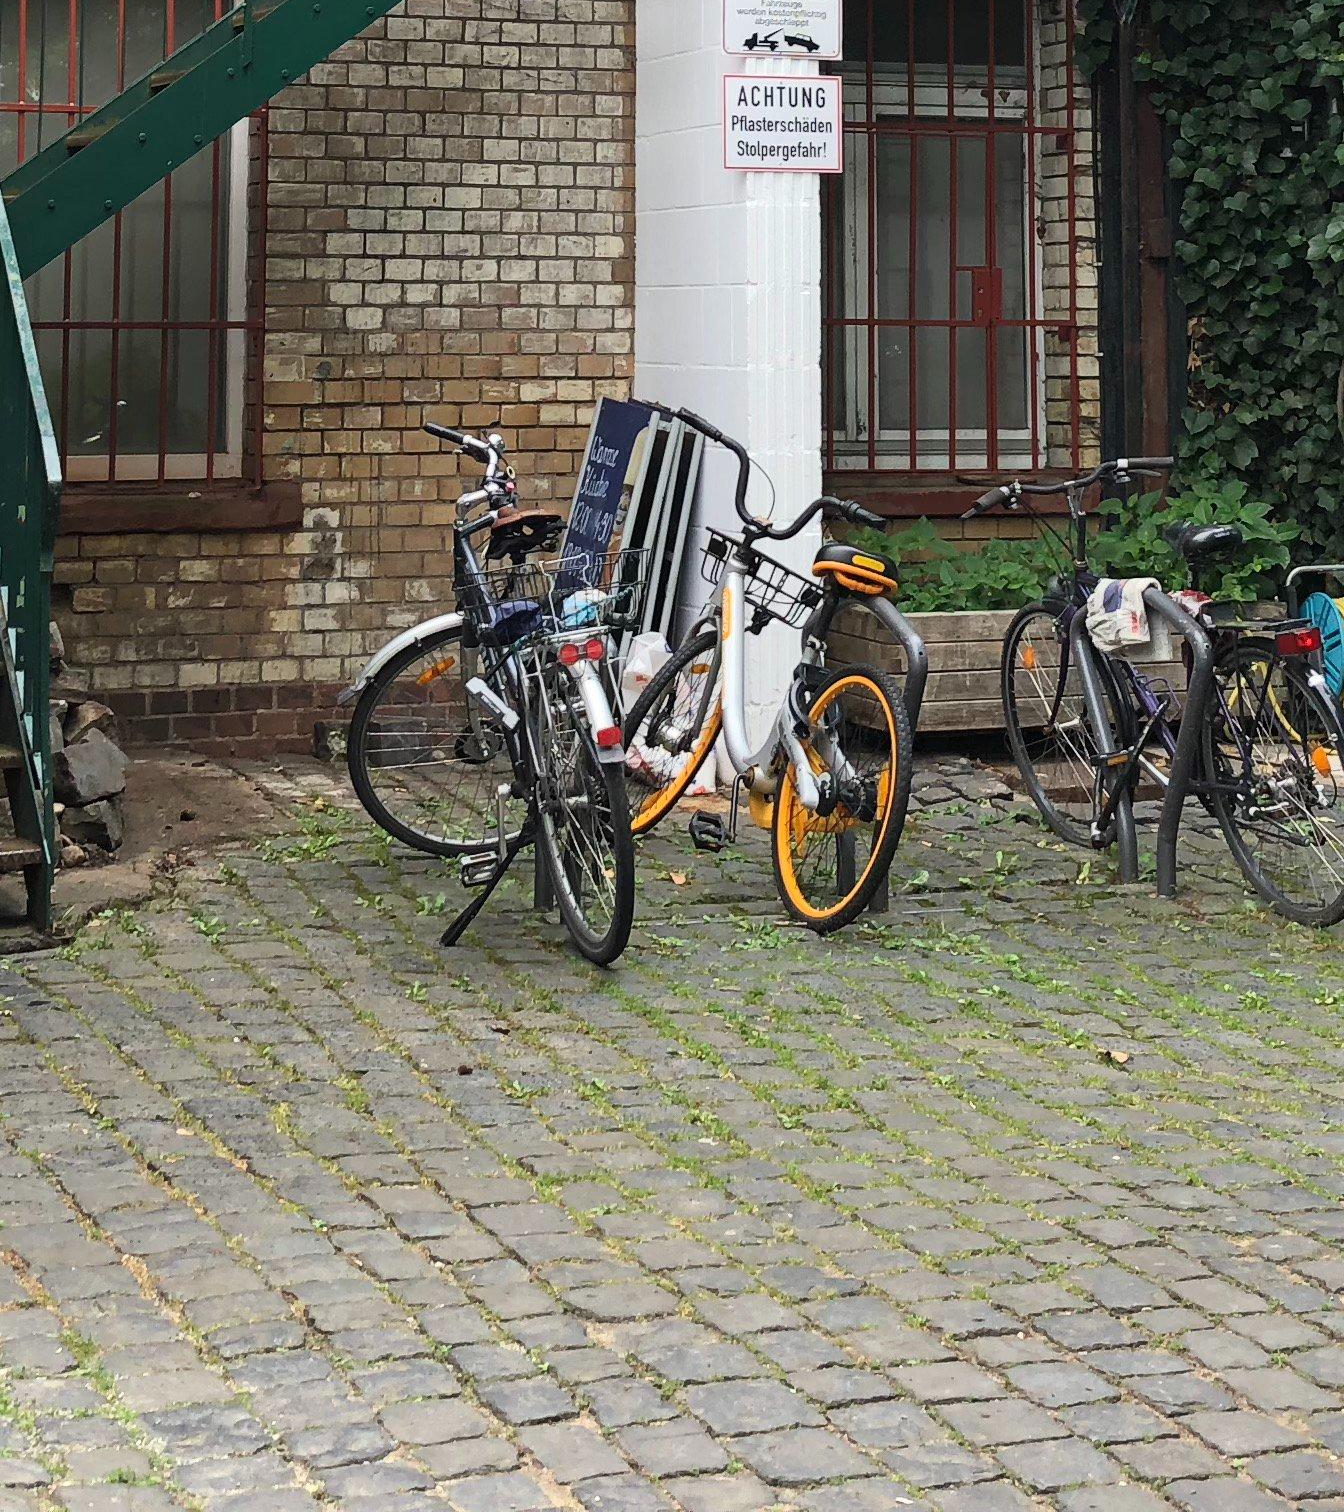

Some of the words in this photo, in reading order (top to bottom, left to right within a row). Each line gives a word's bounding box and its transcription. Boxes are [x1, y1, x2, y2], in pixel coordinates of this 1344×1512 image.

[737, 86, 826, 108] ACHTUNG
[731, 115, 833, 134] Pflasterschäden
[737, 140, 827, 162] Stolpergefahr!
